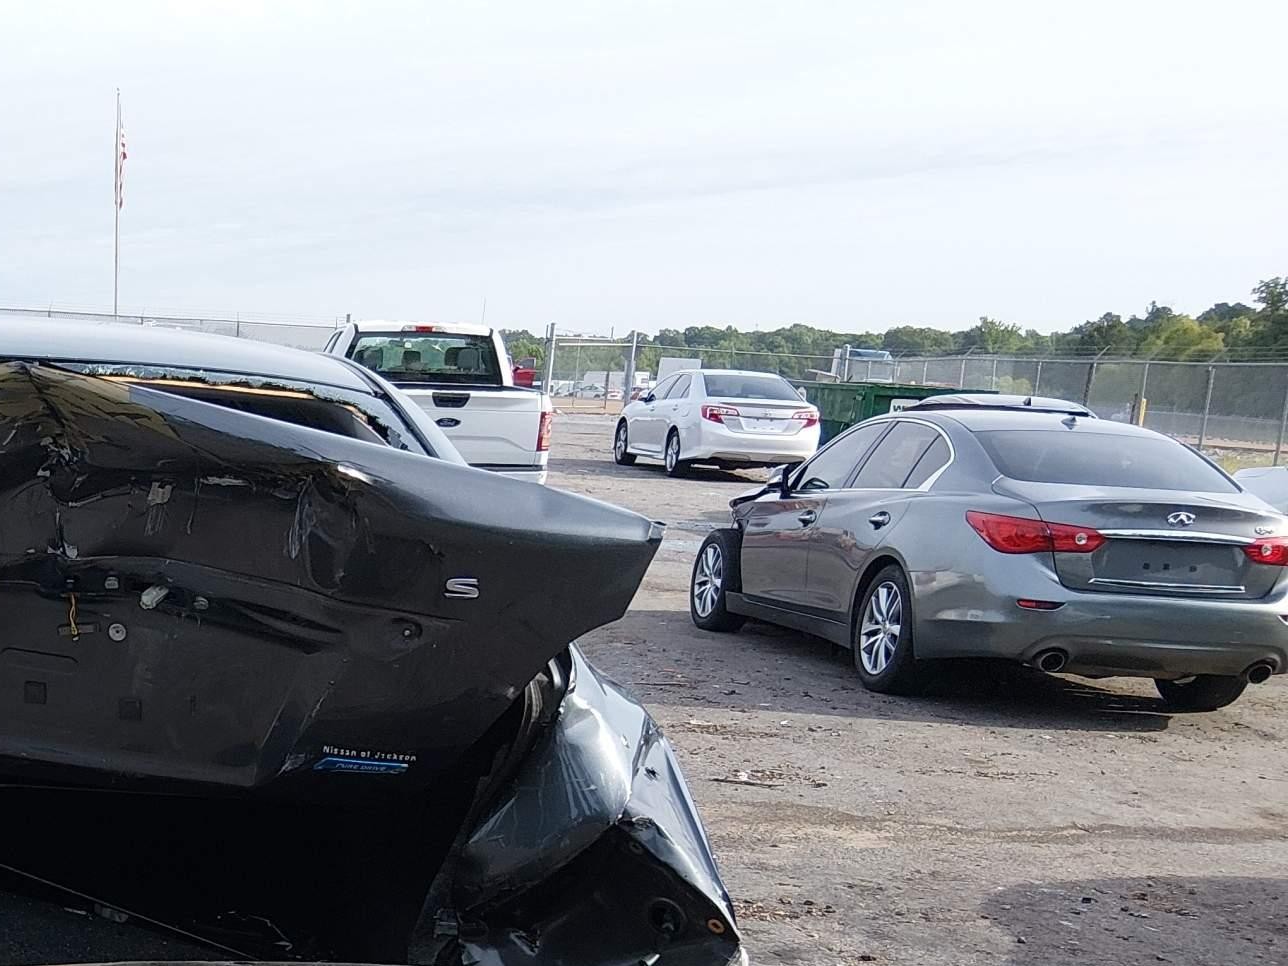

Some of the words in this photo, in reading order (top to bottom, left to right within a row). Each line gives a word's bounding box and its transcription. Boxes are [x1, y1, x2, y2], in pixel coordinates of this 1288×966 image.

[444, 578, 479, 598] S
[323, 746, 357, 757] Nissan
[360, 750, 371, 758] of
